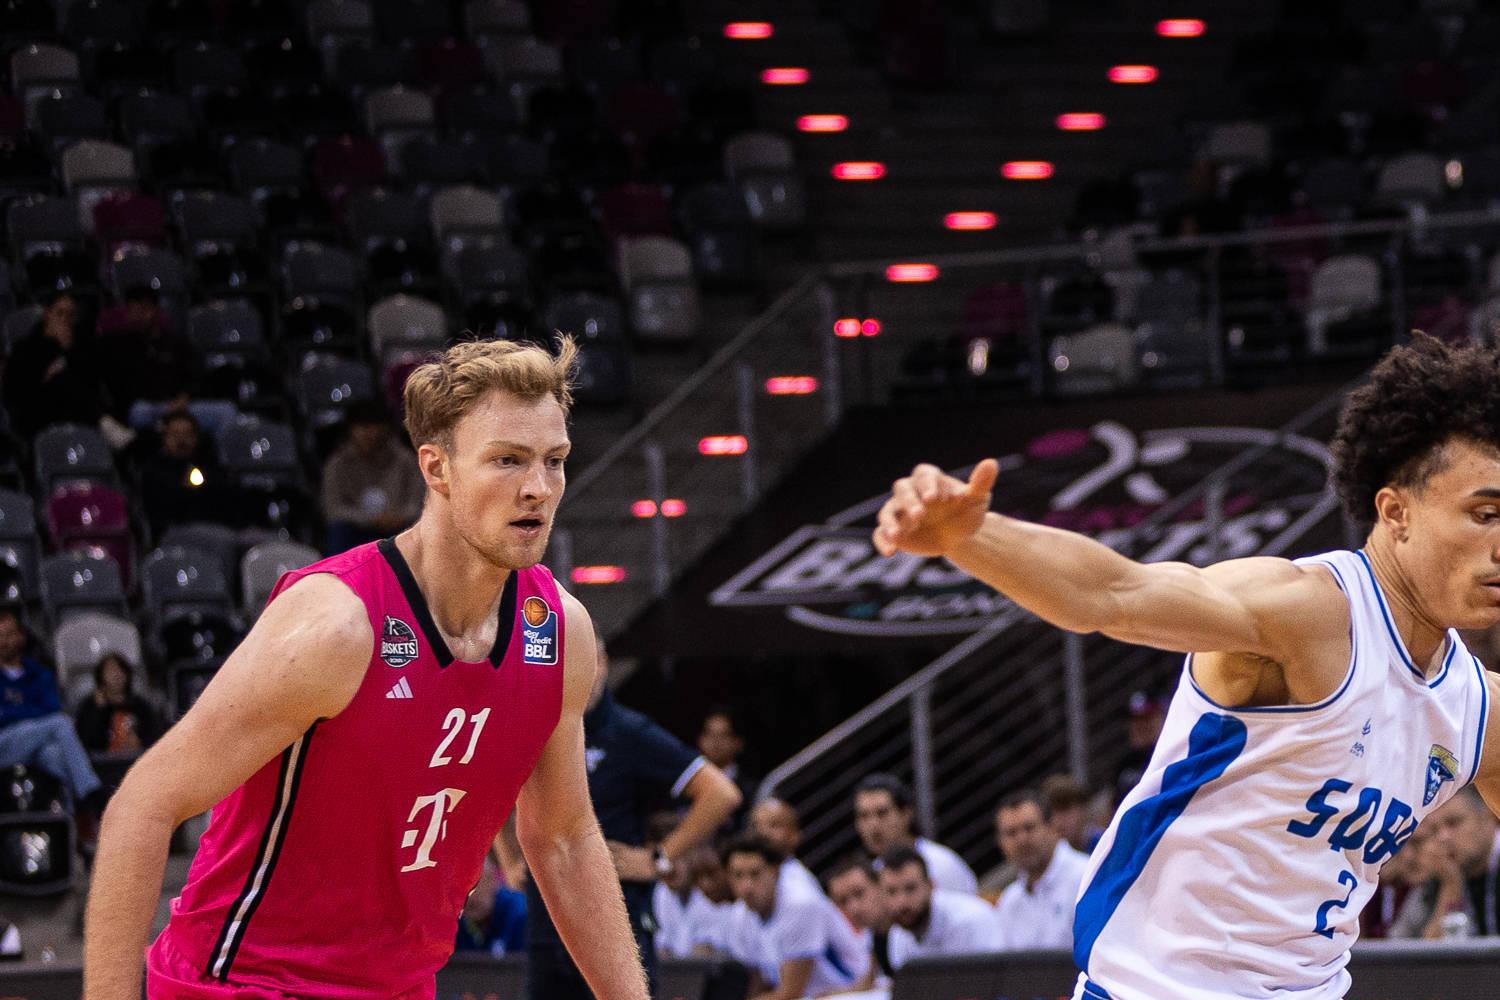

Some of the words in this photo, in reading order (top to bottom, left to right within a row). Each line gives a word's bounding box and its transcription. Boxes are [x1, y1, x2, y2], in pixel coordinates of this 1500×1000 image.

[524, 643, 552, 659] BBL
[428, 707, 491, 768] 21
[1312, 869, 1358, 940] 2
